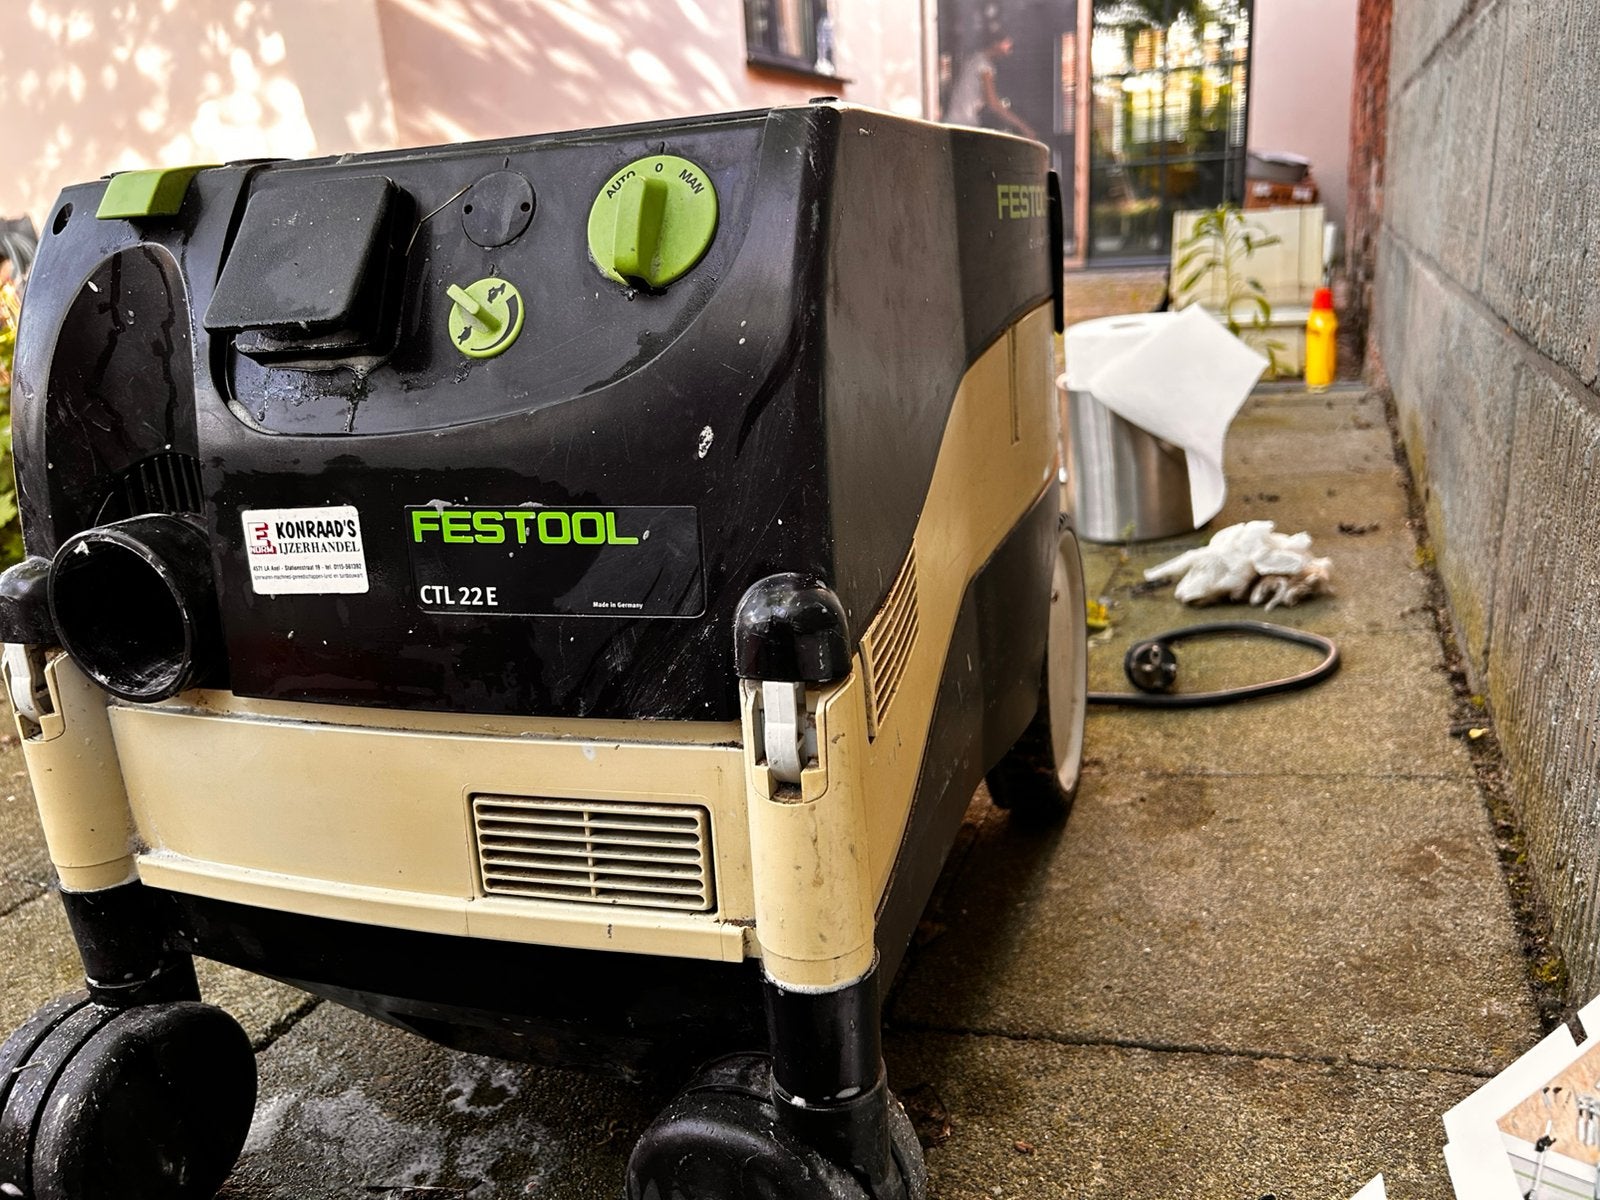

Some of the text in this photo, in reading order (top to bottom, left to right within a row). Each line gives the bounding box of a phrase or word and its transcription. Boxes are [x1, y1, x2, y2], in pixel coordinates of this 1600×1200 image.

[678, 169, 705, 195] MAN
[997, 184, 1046, 220] FESTO
[275, 519, 357, 539] KONRAAD'S
[411, 511, 639, 545] FESTOOL
[278, 541, 361, 555] IJZERHANDEL
[420, 585, 498, 606] CTL 22 E
[617, 601, 644, 610] Germany
